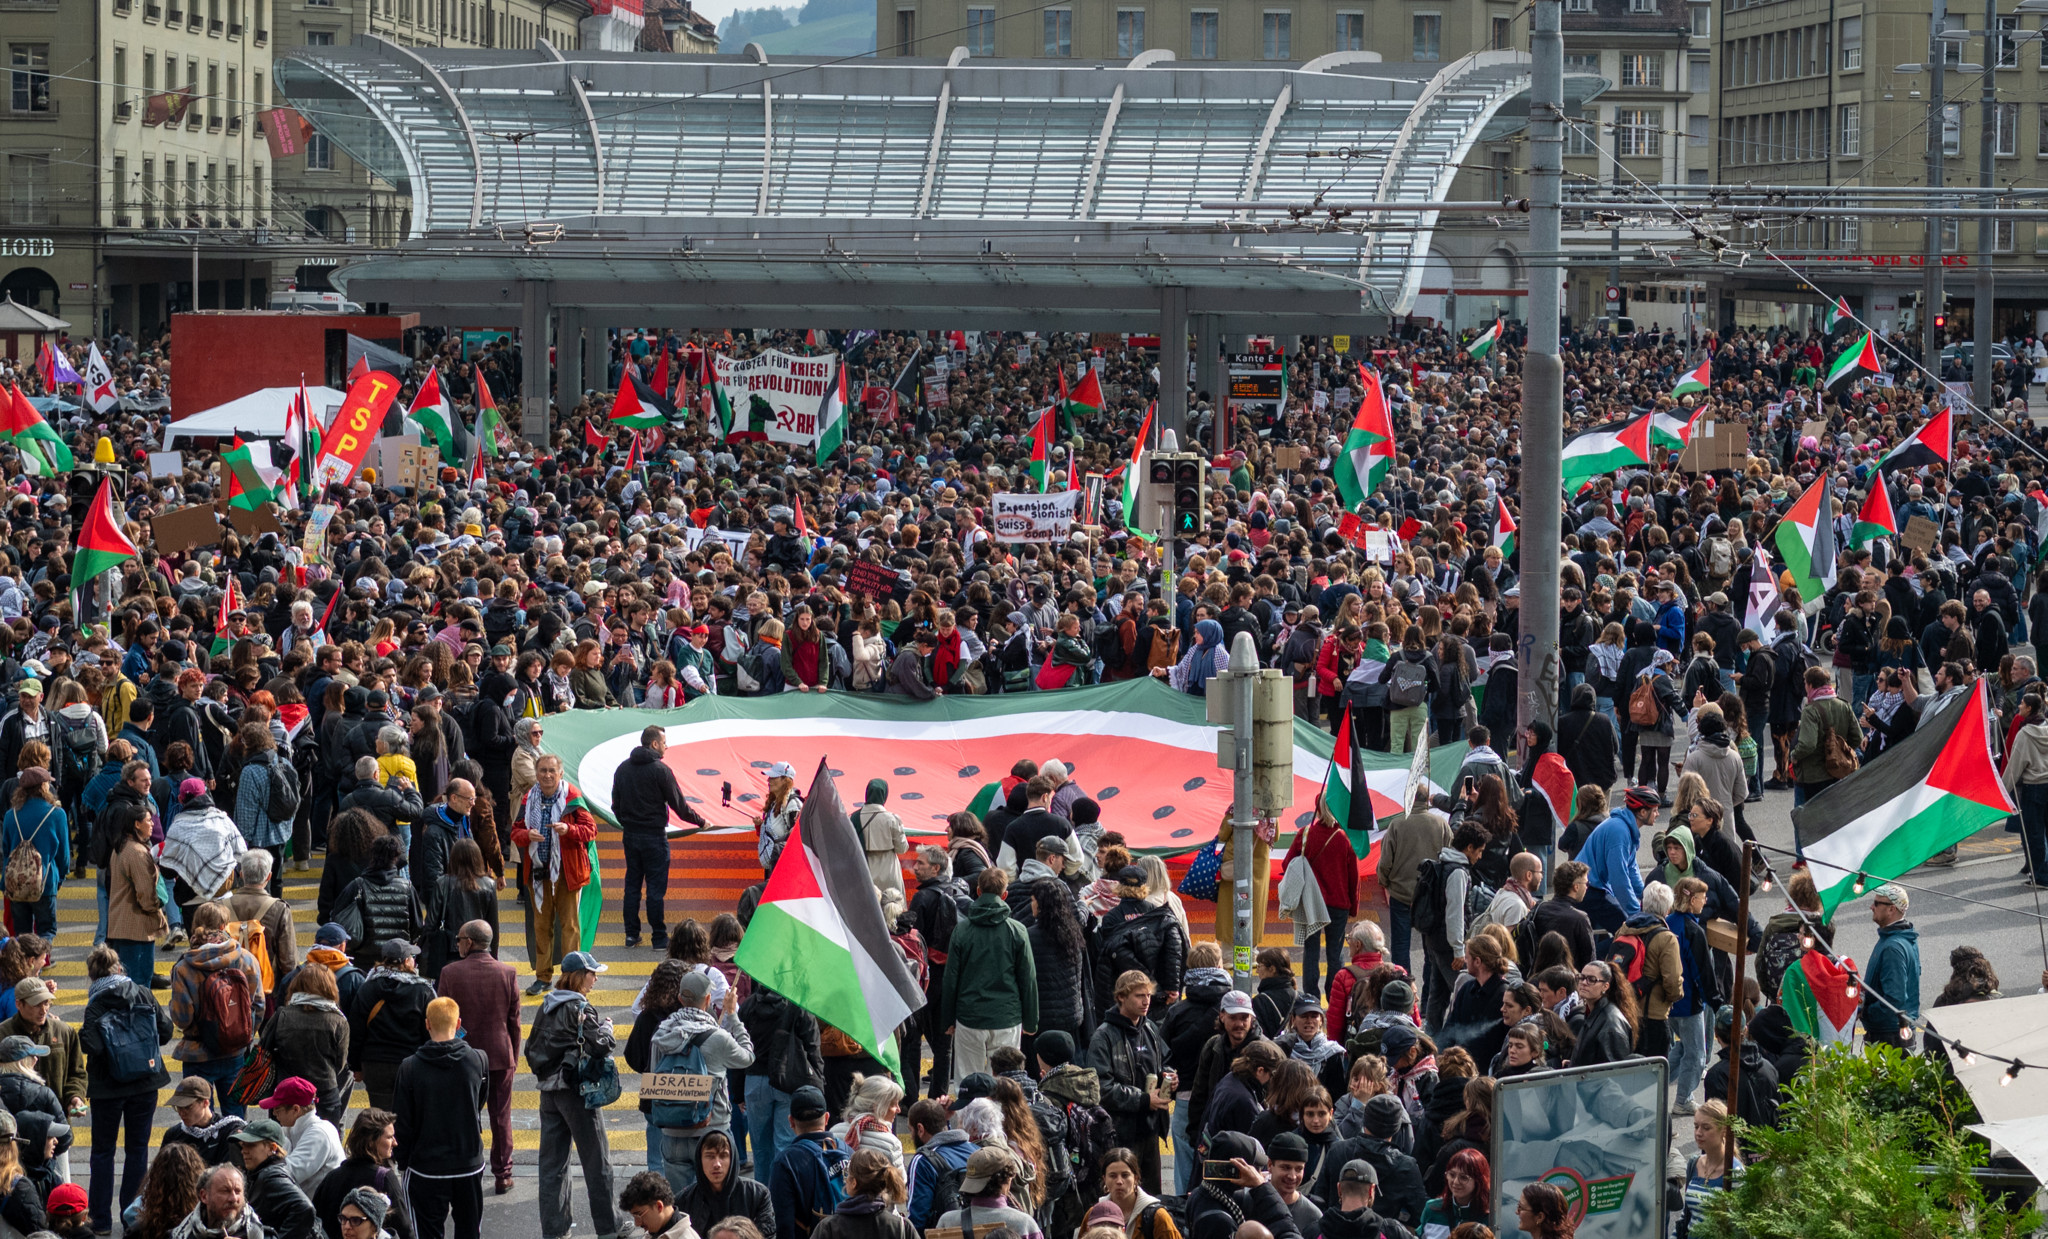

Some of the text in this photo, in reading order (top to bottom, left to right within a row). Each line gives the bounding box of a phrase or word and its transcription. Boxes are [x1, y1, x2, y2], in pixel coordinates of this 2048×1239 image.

[1, 238, 55, 256] LOEB
[1236, 354, 1274, 363] Kante E
[717, 358, 733, 371] SIE
[771, 357, 789, 369] FÜR
[790, 361, 828, 378] KRIEG!
[733, 375, 748, 387] FÜR
[748, 374, 828, 397] REVOLUTION!
[852, 567, 867, 577] END
[652, 1075, 709, 1087] ISRAEL:
[640, 1087, 677, 1096] SANCTIONS
